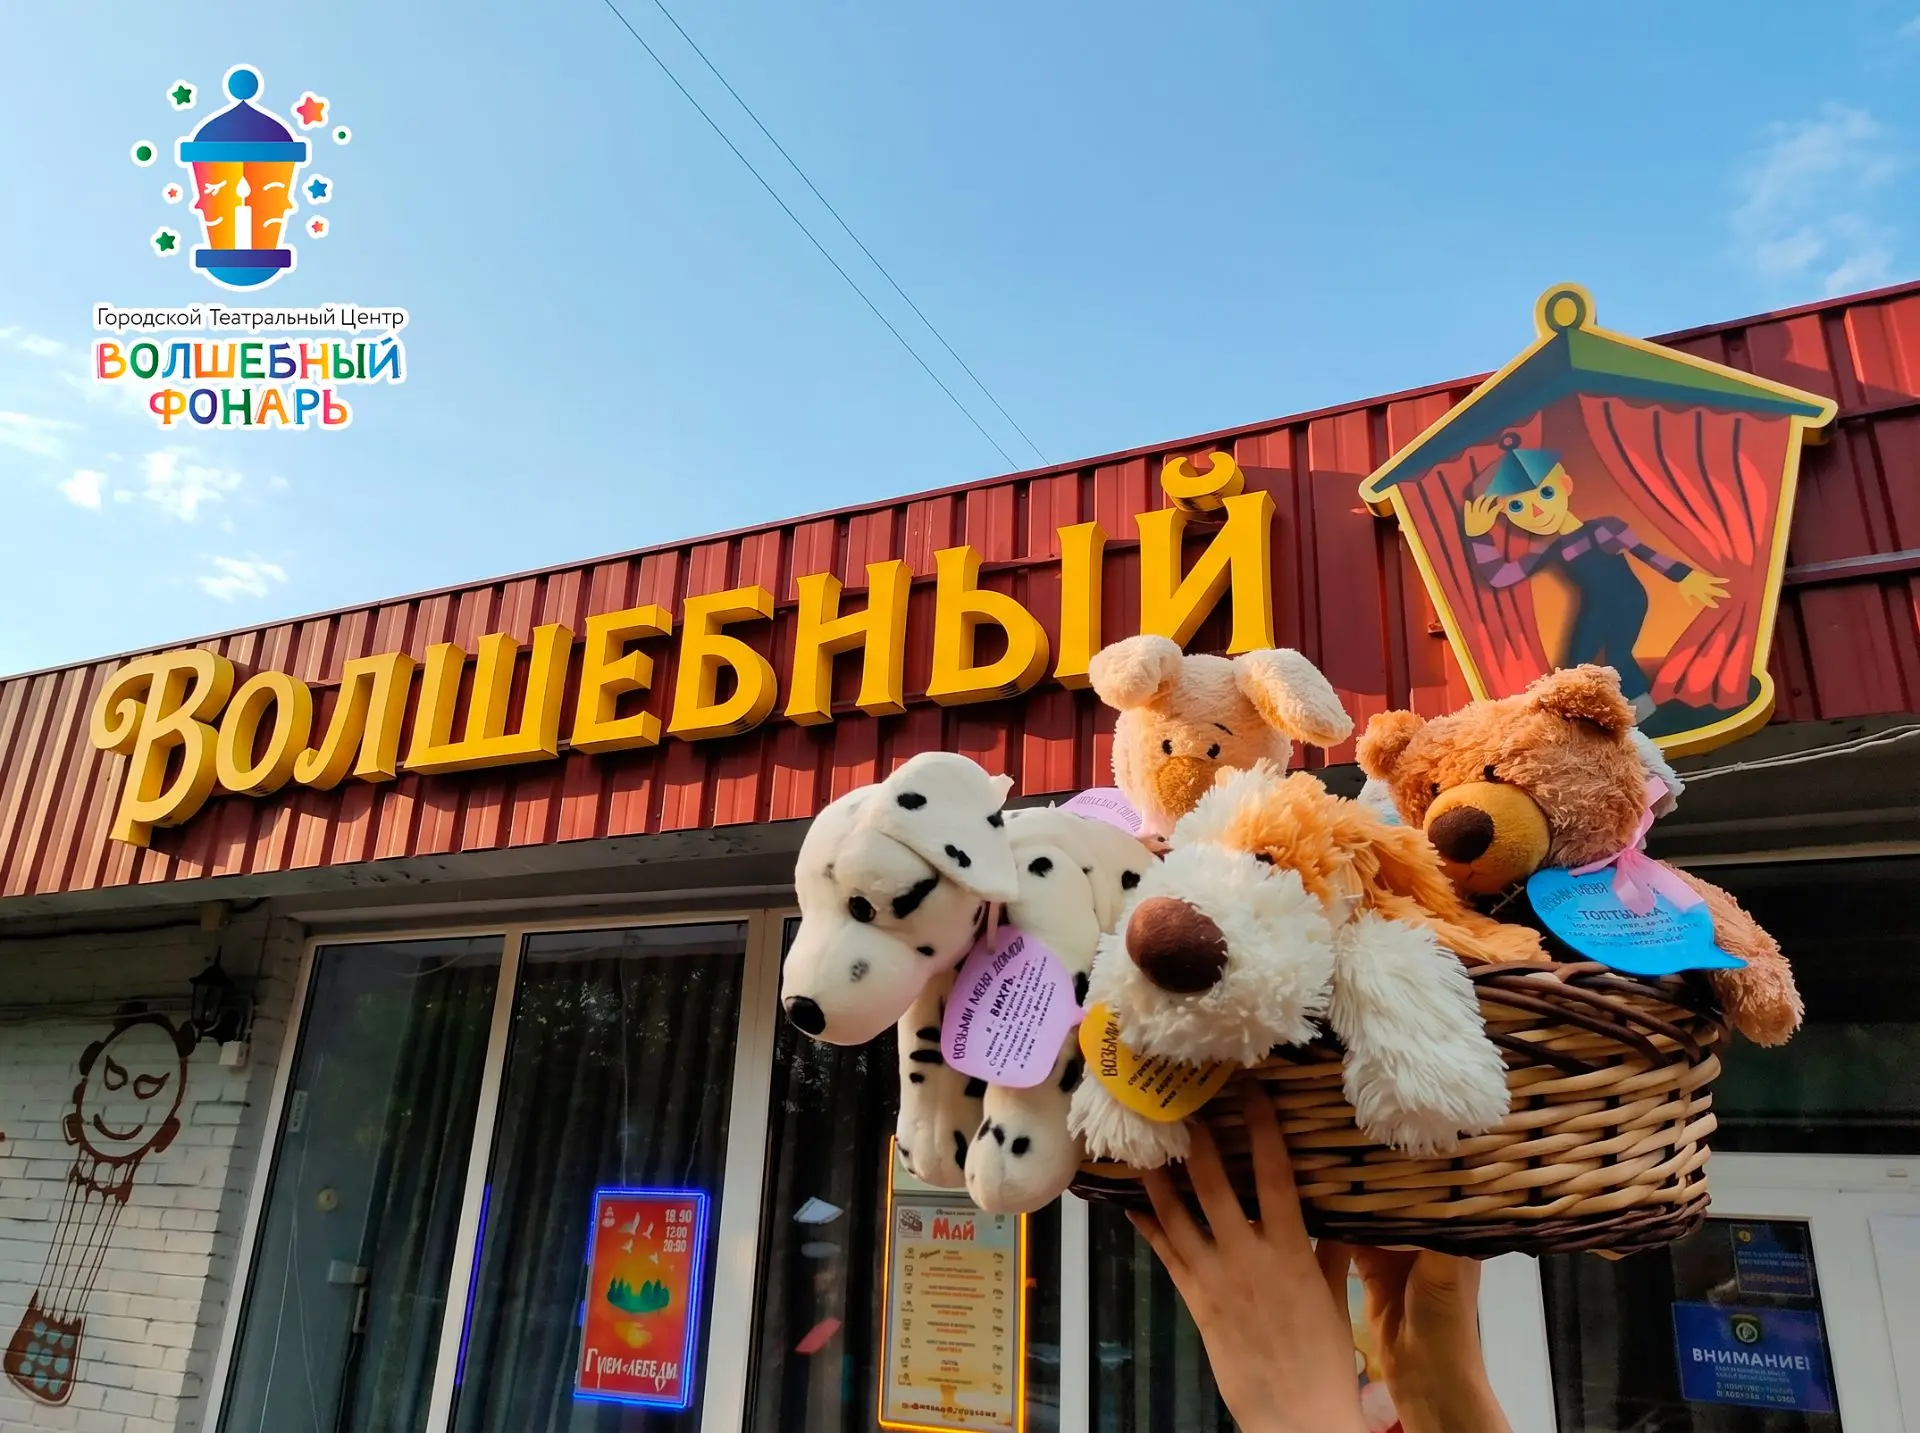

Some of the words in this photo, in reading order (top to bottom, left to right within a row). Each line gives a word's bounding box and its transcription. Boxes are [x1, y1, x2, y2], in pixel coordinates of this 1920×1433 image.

[952, 1008, 976, 1060] ВОЗЬМИ
[968, 972, 994, 1006] МЕНЯ
[1100, 1021, 1120, 1077] ВОЗЬМИ
[1692, 1347, 1811, 1372] ВНИМАНИЕ!
